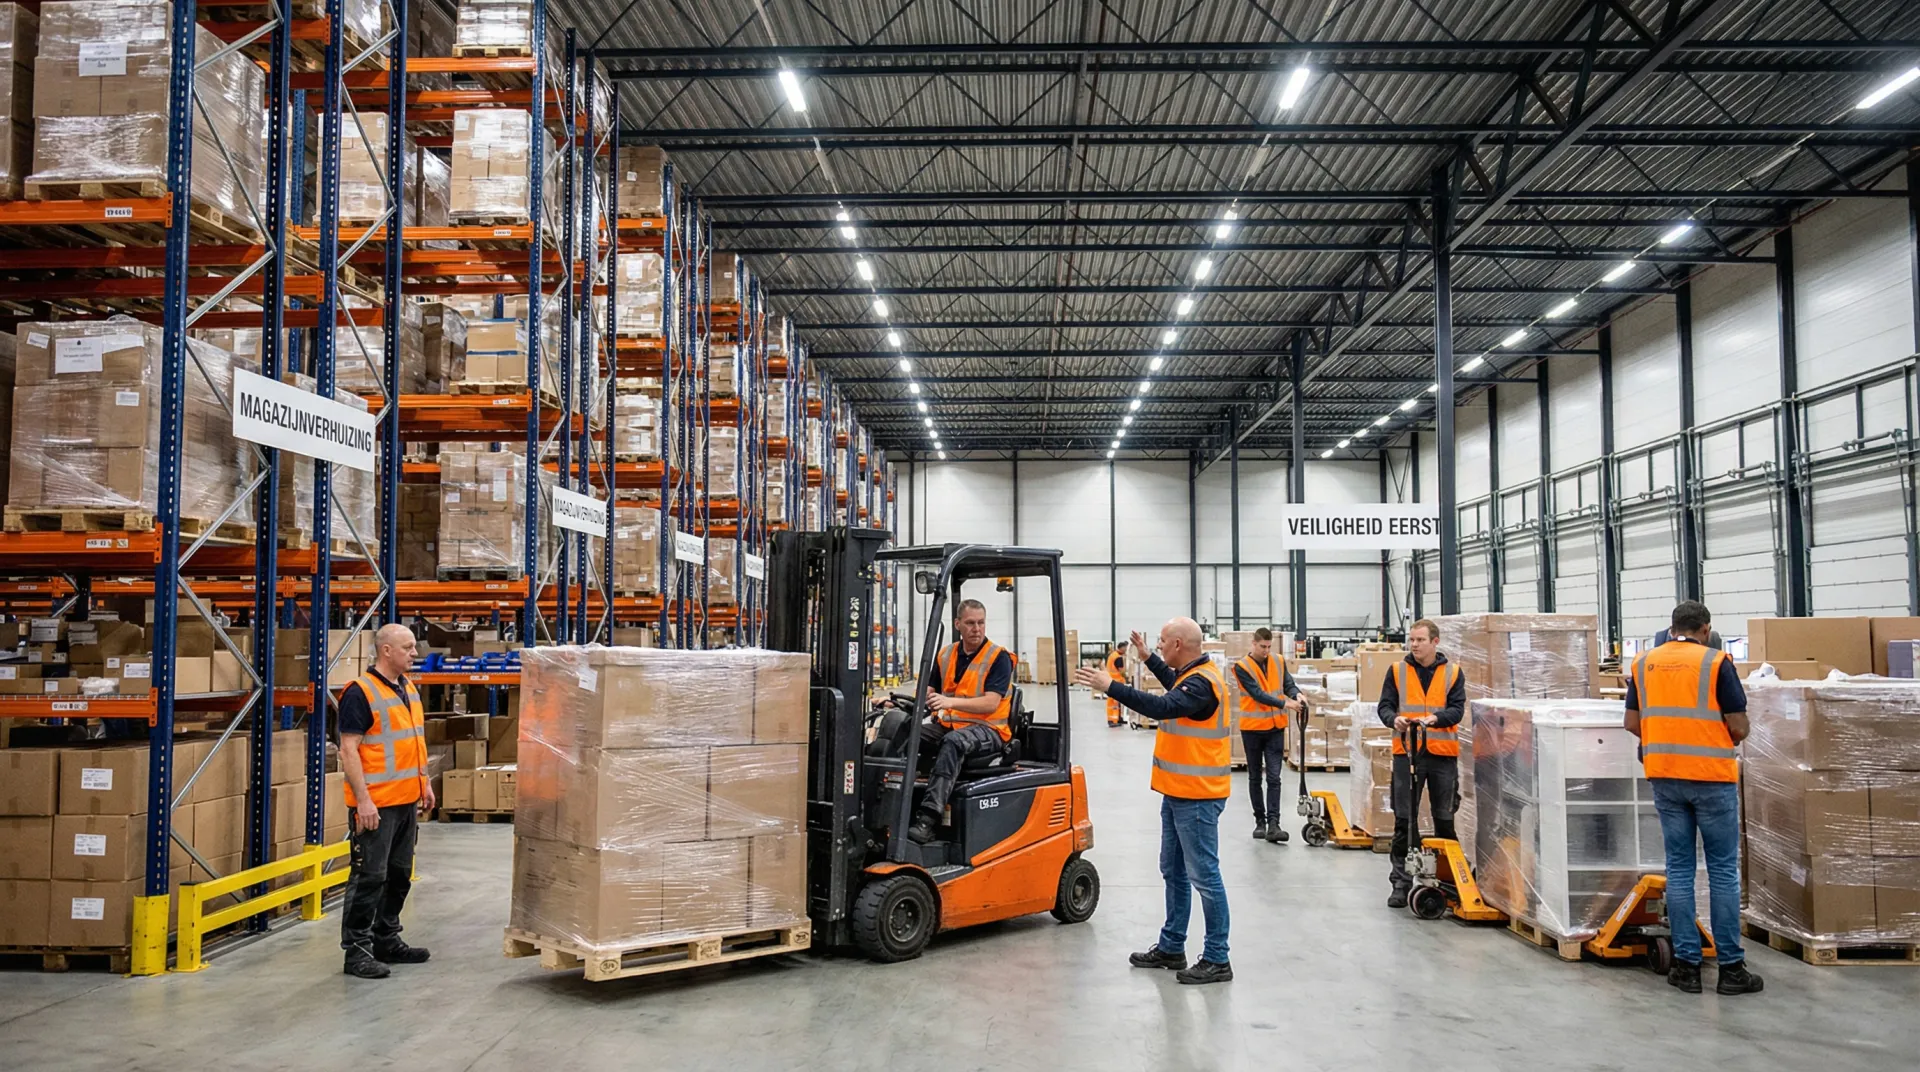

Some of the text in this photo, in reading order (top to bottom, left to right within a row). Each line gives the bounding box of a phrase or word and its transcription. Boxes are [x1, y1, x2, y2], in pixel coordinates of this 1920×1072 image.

[240, 391, 372, 453] MAGAZIJNVERHUIZING
[1287, 517, 1440, 535] VEILIGHEID EERST
